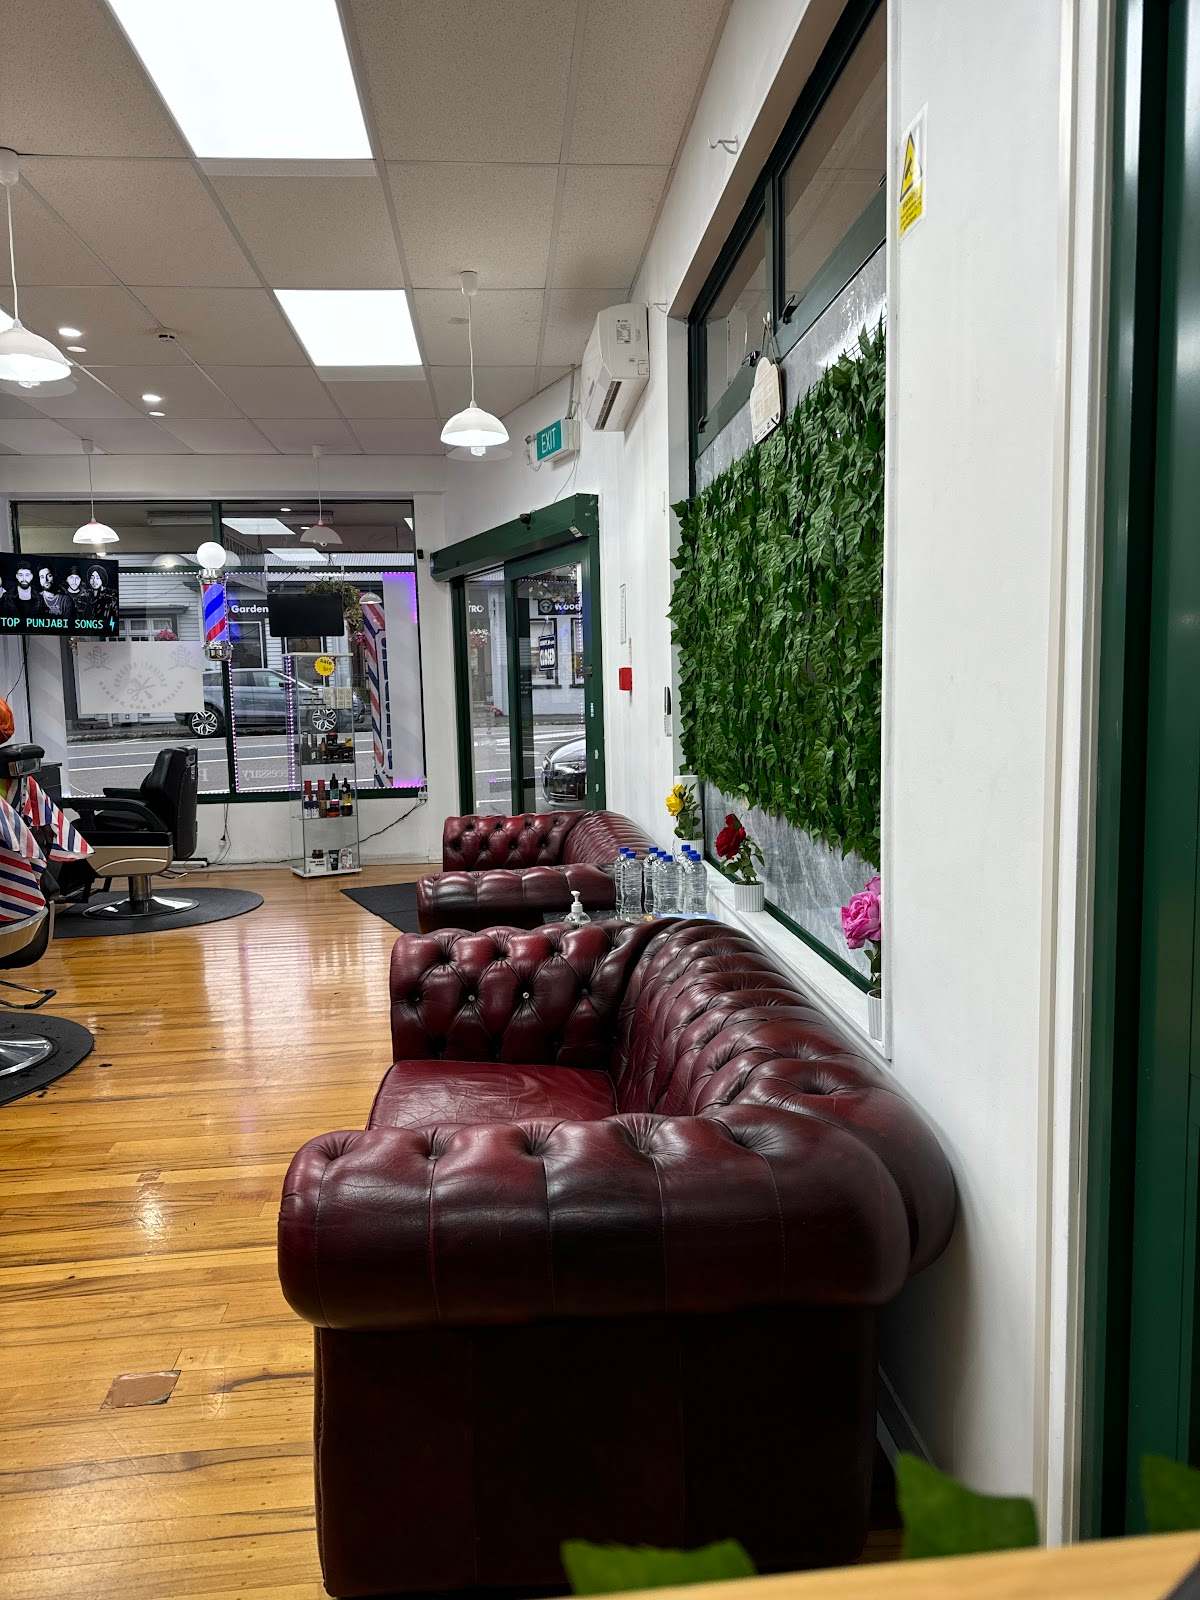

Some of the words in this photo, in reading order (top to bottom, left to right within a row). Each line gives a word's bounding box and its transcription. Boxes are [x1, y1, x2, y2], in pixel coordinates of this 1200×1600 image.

[541, 427, 556, 454] EXIT
[231, 604, 269, 613] Garden
[0, 617, 20, 627] TOP
[26, 618, 69, 628] PUNJABI
[75, 619, 104, 629] SONGS
